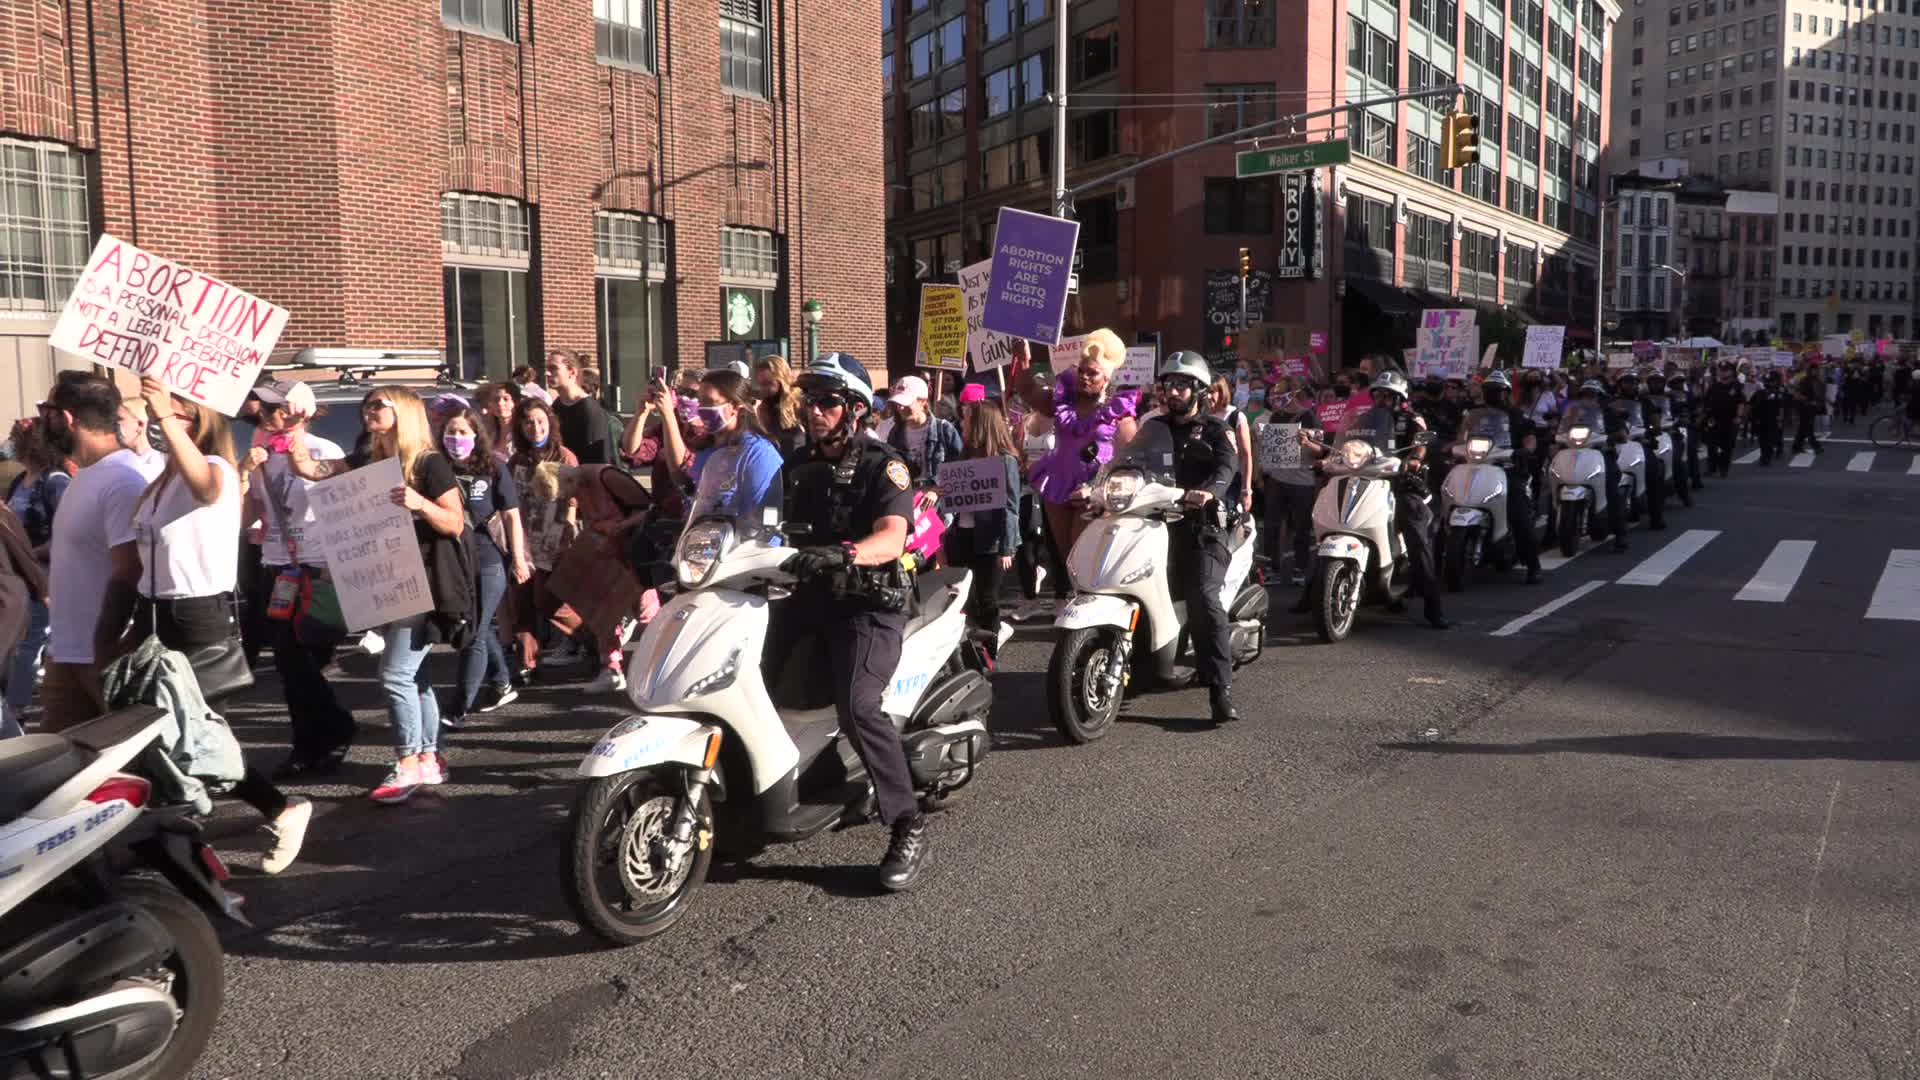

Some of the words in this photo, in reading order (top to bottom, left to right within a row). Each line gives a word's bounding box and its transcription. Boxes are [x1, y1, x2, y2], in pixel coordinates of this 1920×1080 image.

[1267, 153, 1300, 167] Walker
[1303, 150, 1315, 162] St
[1286, 188, 1299, 263] ROXY
[1000, 244, 1064, 265] ABORTION
[1008, 257, 1053, 275] RIGHTS
[1014, 271, 1040, 285] ARE
[93, 243, 274, 341] ABORTION
[1006, 280, 1047, 300] LGBTQ
[1001, 291, 1045, 310] RIGHTS
[100, 285, 112, 301] A
[116, 288, 190, 332] PERSONAL
[196, 324, 264, 367] DECISION
[1425, 311, 1460, 329] NOT
[74, 297, 106, 323] NOT
[108, 311, 119, 327] A
[126, 315, 173, 344] LEGAL
[180, 335, 246, 379] DEBATE
[78, 323, 160, 374] DEFEND
[162, 351, 220, 401] ROE
[1344, 429, 1377, 437] POLICE
[942, 465, 975, 481] BANS
[943, 480, 968, 495] OFF
[970, 478, 999, 491] OUR
[943, 491, 993, 508] BODIES
[893, 672, 928, 697] NYPD
